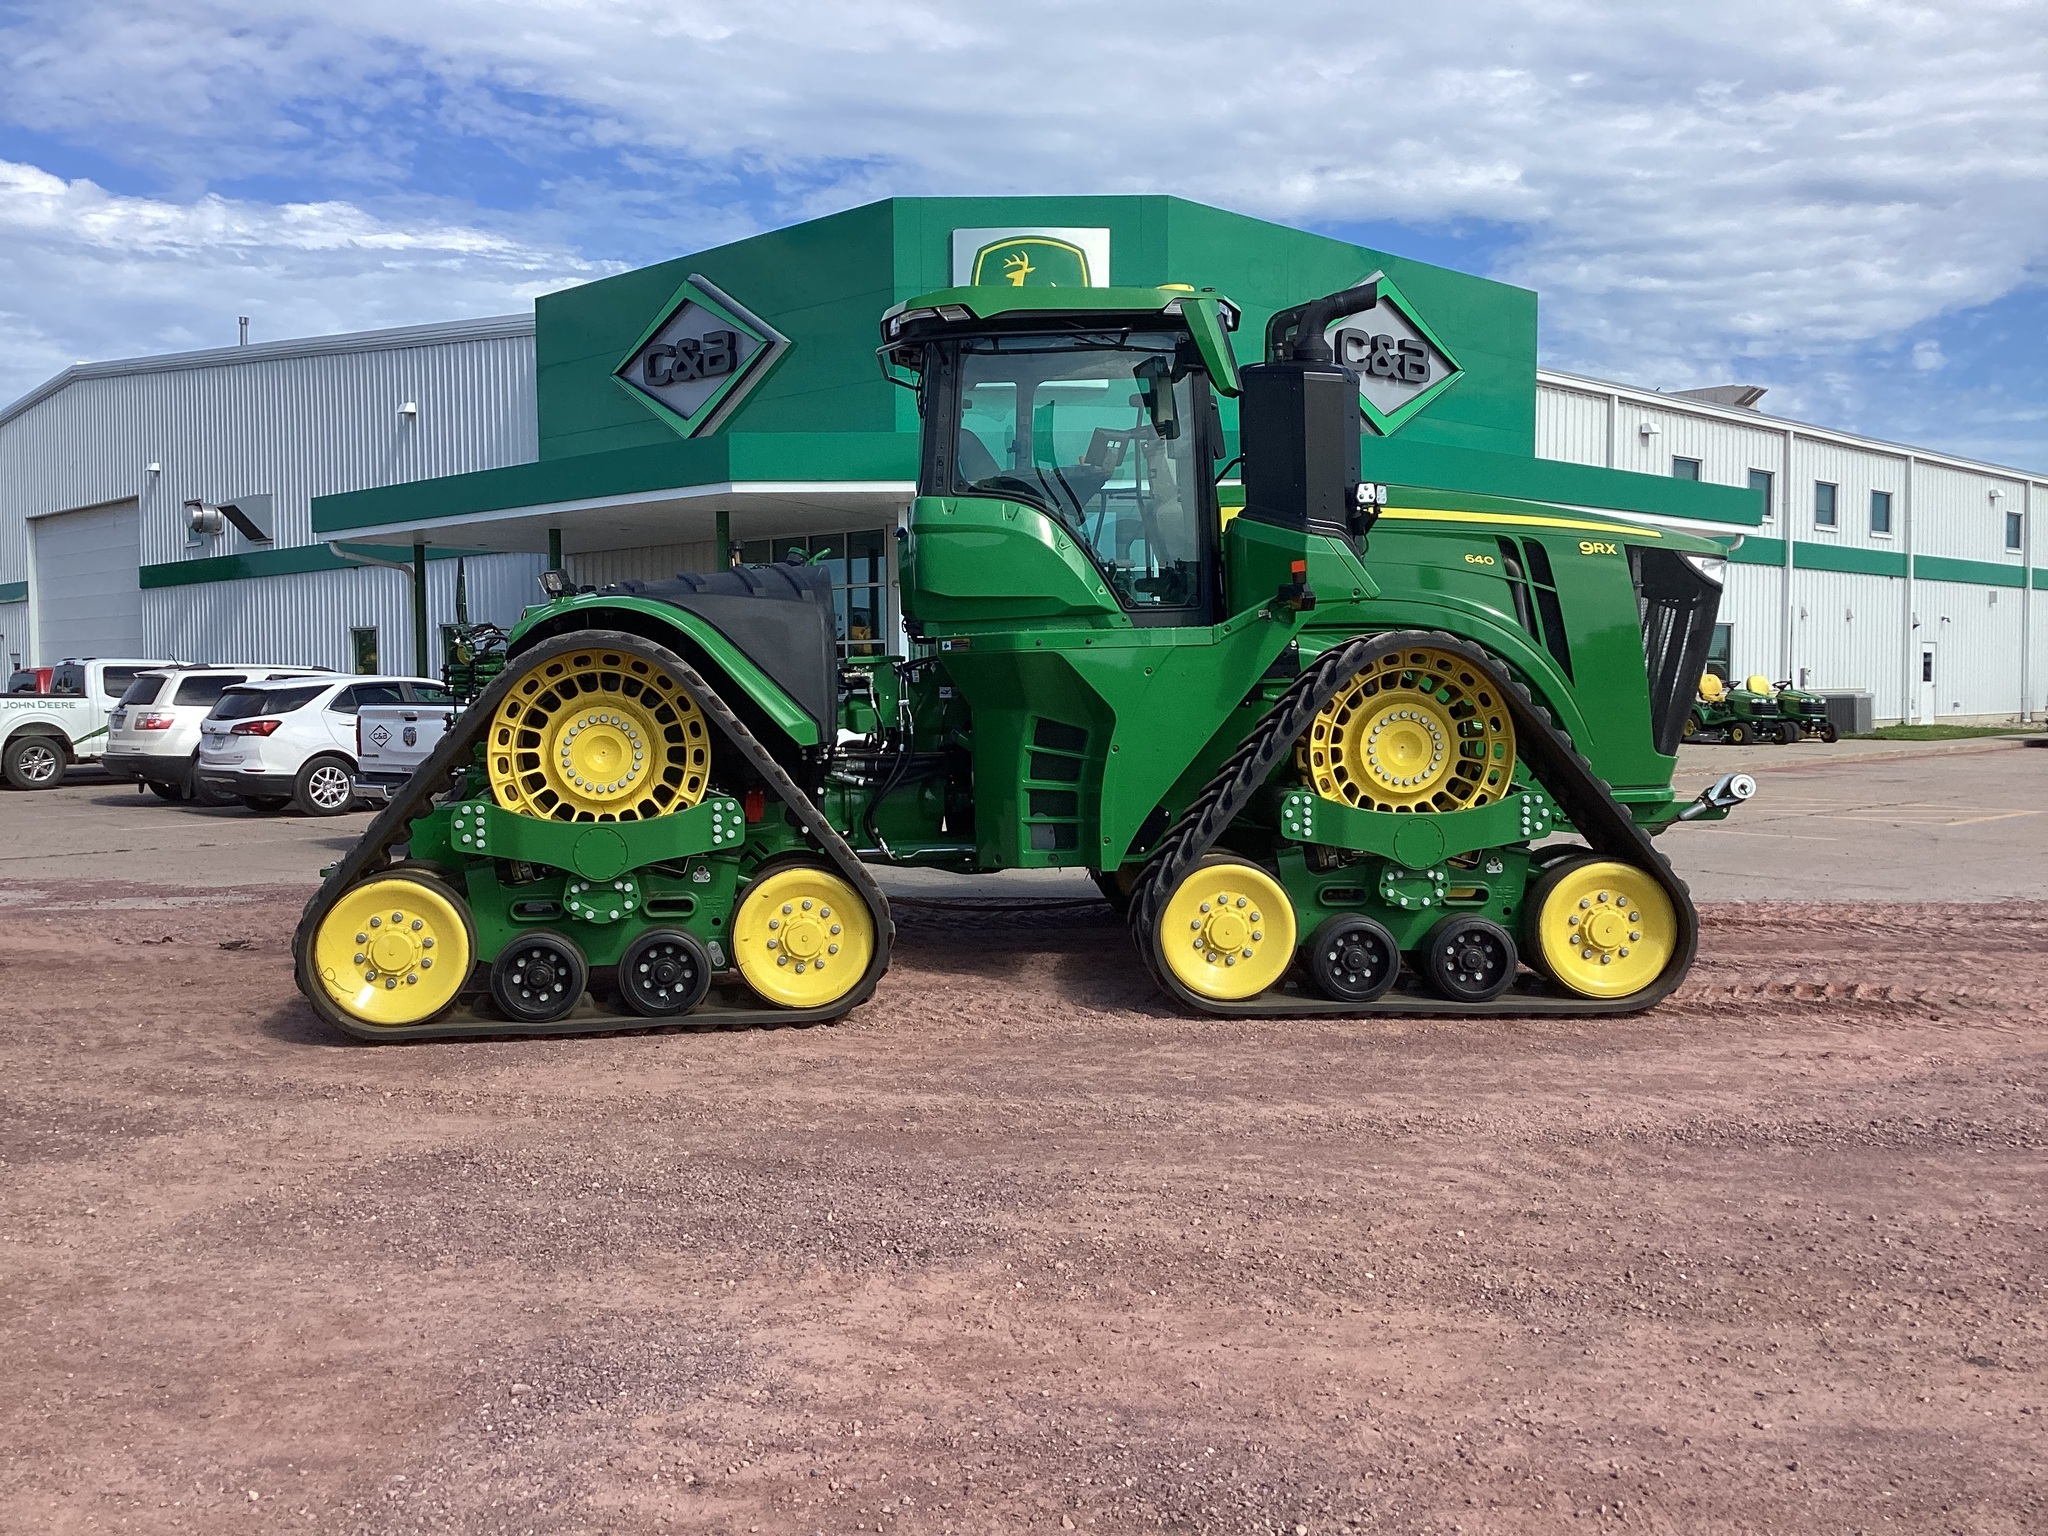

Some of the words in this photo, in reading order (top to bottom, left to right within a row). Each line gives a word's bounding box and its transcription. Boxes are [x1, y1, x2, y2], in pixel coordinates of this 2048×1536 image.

[642, 329, 738, 387] C&B
[1334, 327, 1431, 384] C&B
[1578, 541, 1618, 556] 9RX
[1464, 554, 1495, 566] 640
[2, 700, 36, 709] JOHN
[37, 700, 76, 709] DEERE
[373, 732, 388, 740] C&B
